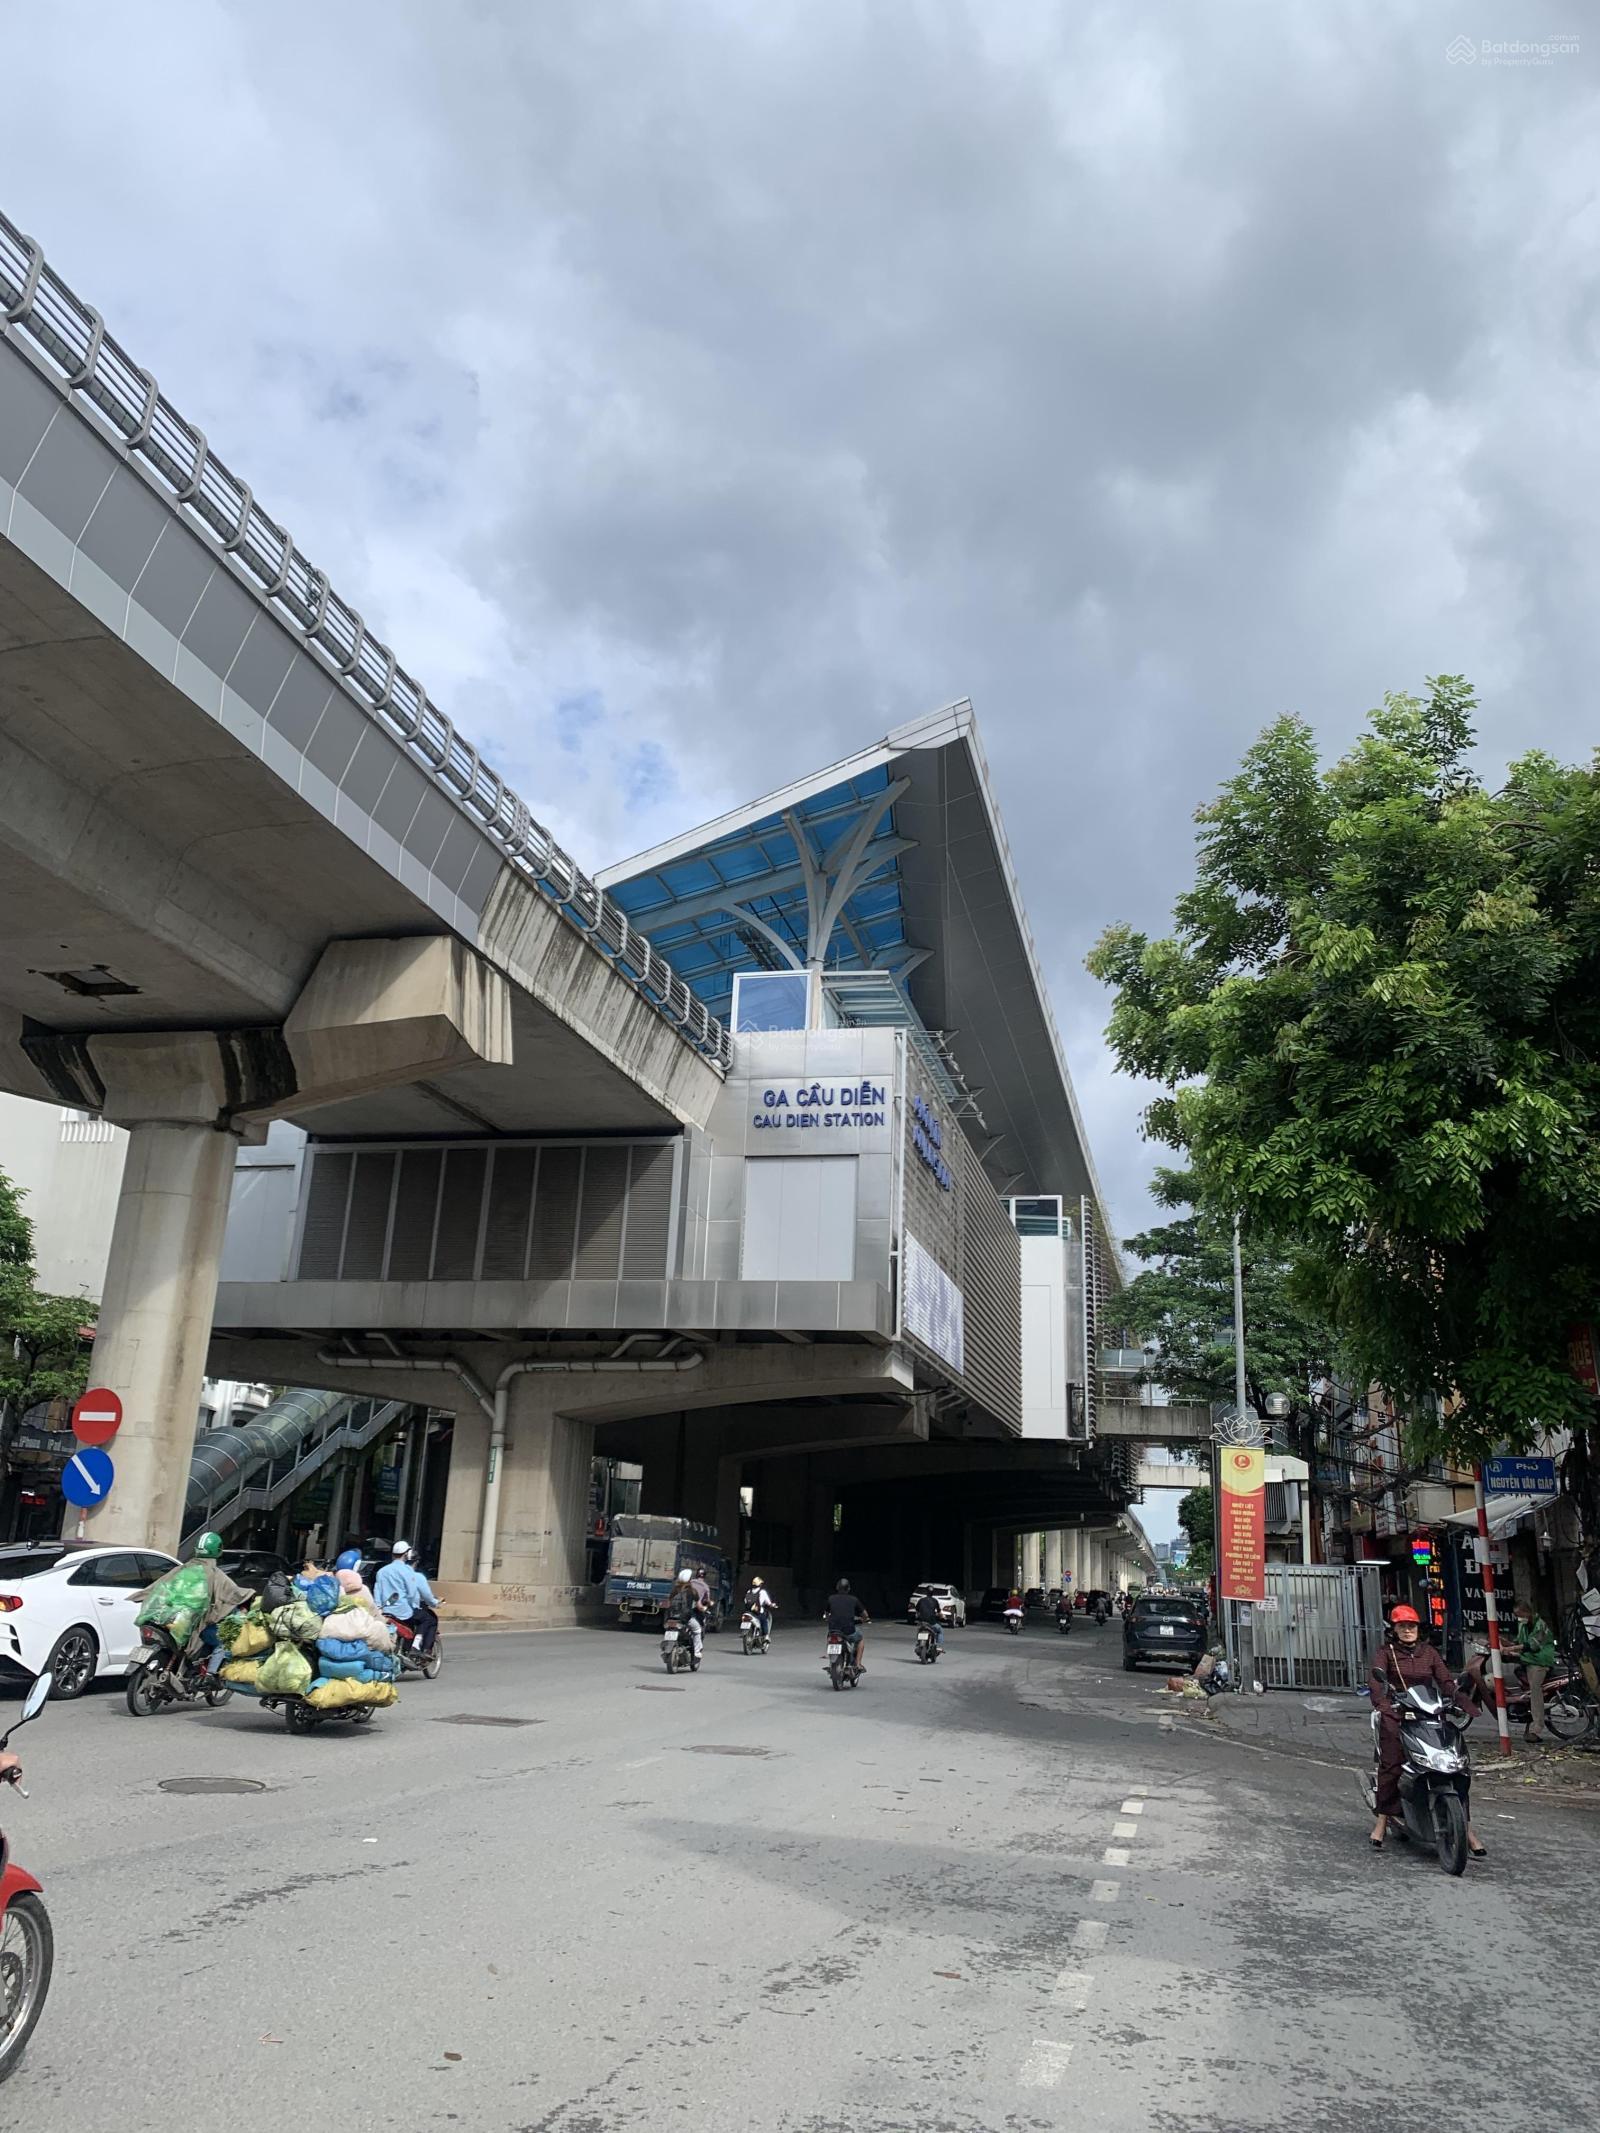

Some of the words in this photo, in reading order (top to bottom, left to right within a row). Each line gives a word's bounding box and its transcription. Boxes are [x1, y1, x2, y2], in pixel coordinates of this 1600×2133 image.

[763, 1089, 789, 1107] GA
[796, 1082, 834, 1106] CẦU
[840, 1081, 885, 1105] DIỄN
[752, 1114, 782, 1128] CAU
[786, 1113, 819, 1128] DIEN
[823, 1112, 885, 1127] STATION
